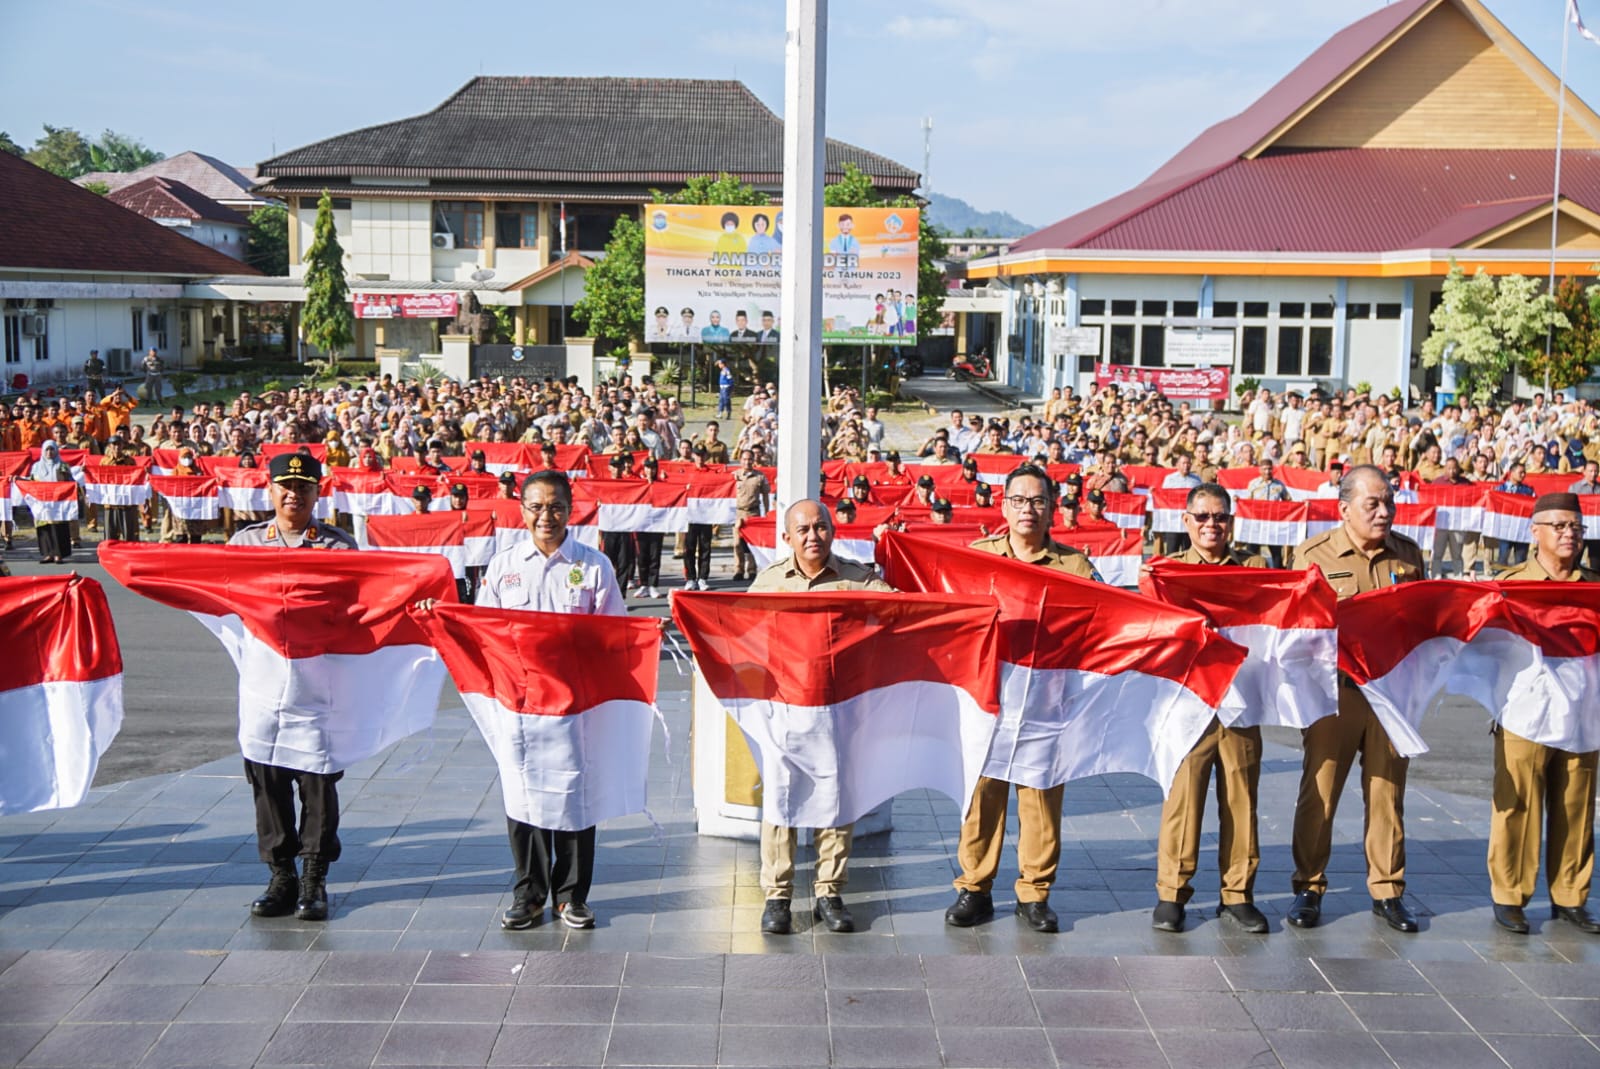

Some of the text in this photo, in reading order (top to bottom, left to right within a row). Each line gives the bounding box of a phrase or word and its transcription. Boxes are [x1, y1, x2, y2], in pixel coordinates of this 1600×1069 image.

[709, 251, 859, 269] JAMBOR DER
[666, 268, 711, 277] TINGKAT
[714, 269, 742, 277] KOTA
[838, 271, 873, 279] TAHUN
[877, 271, 901, 279] 2023
